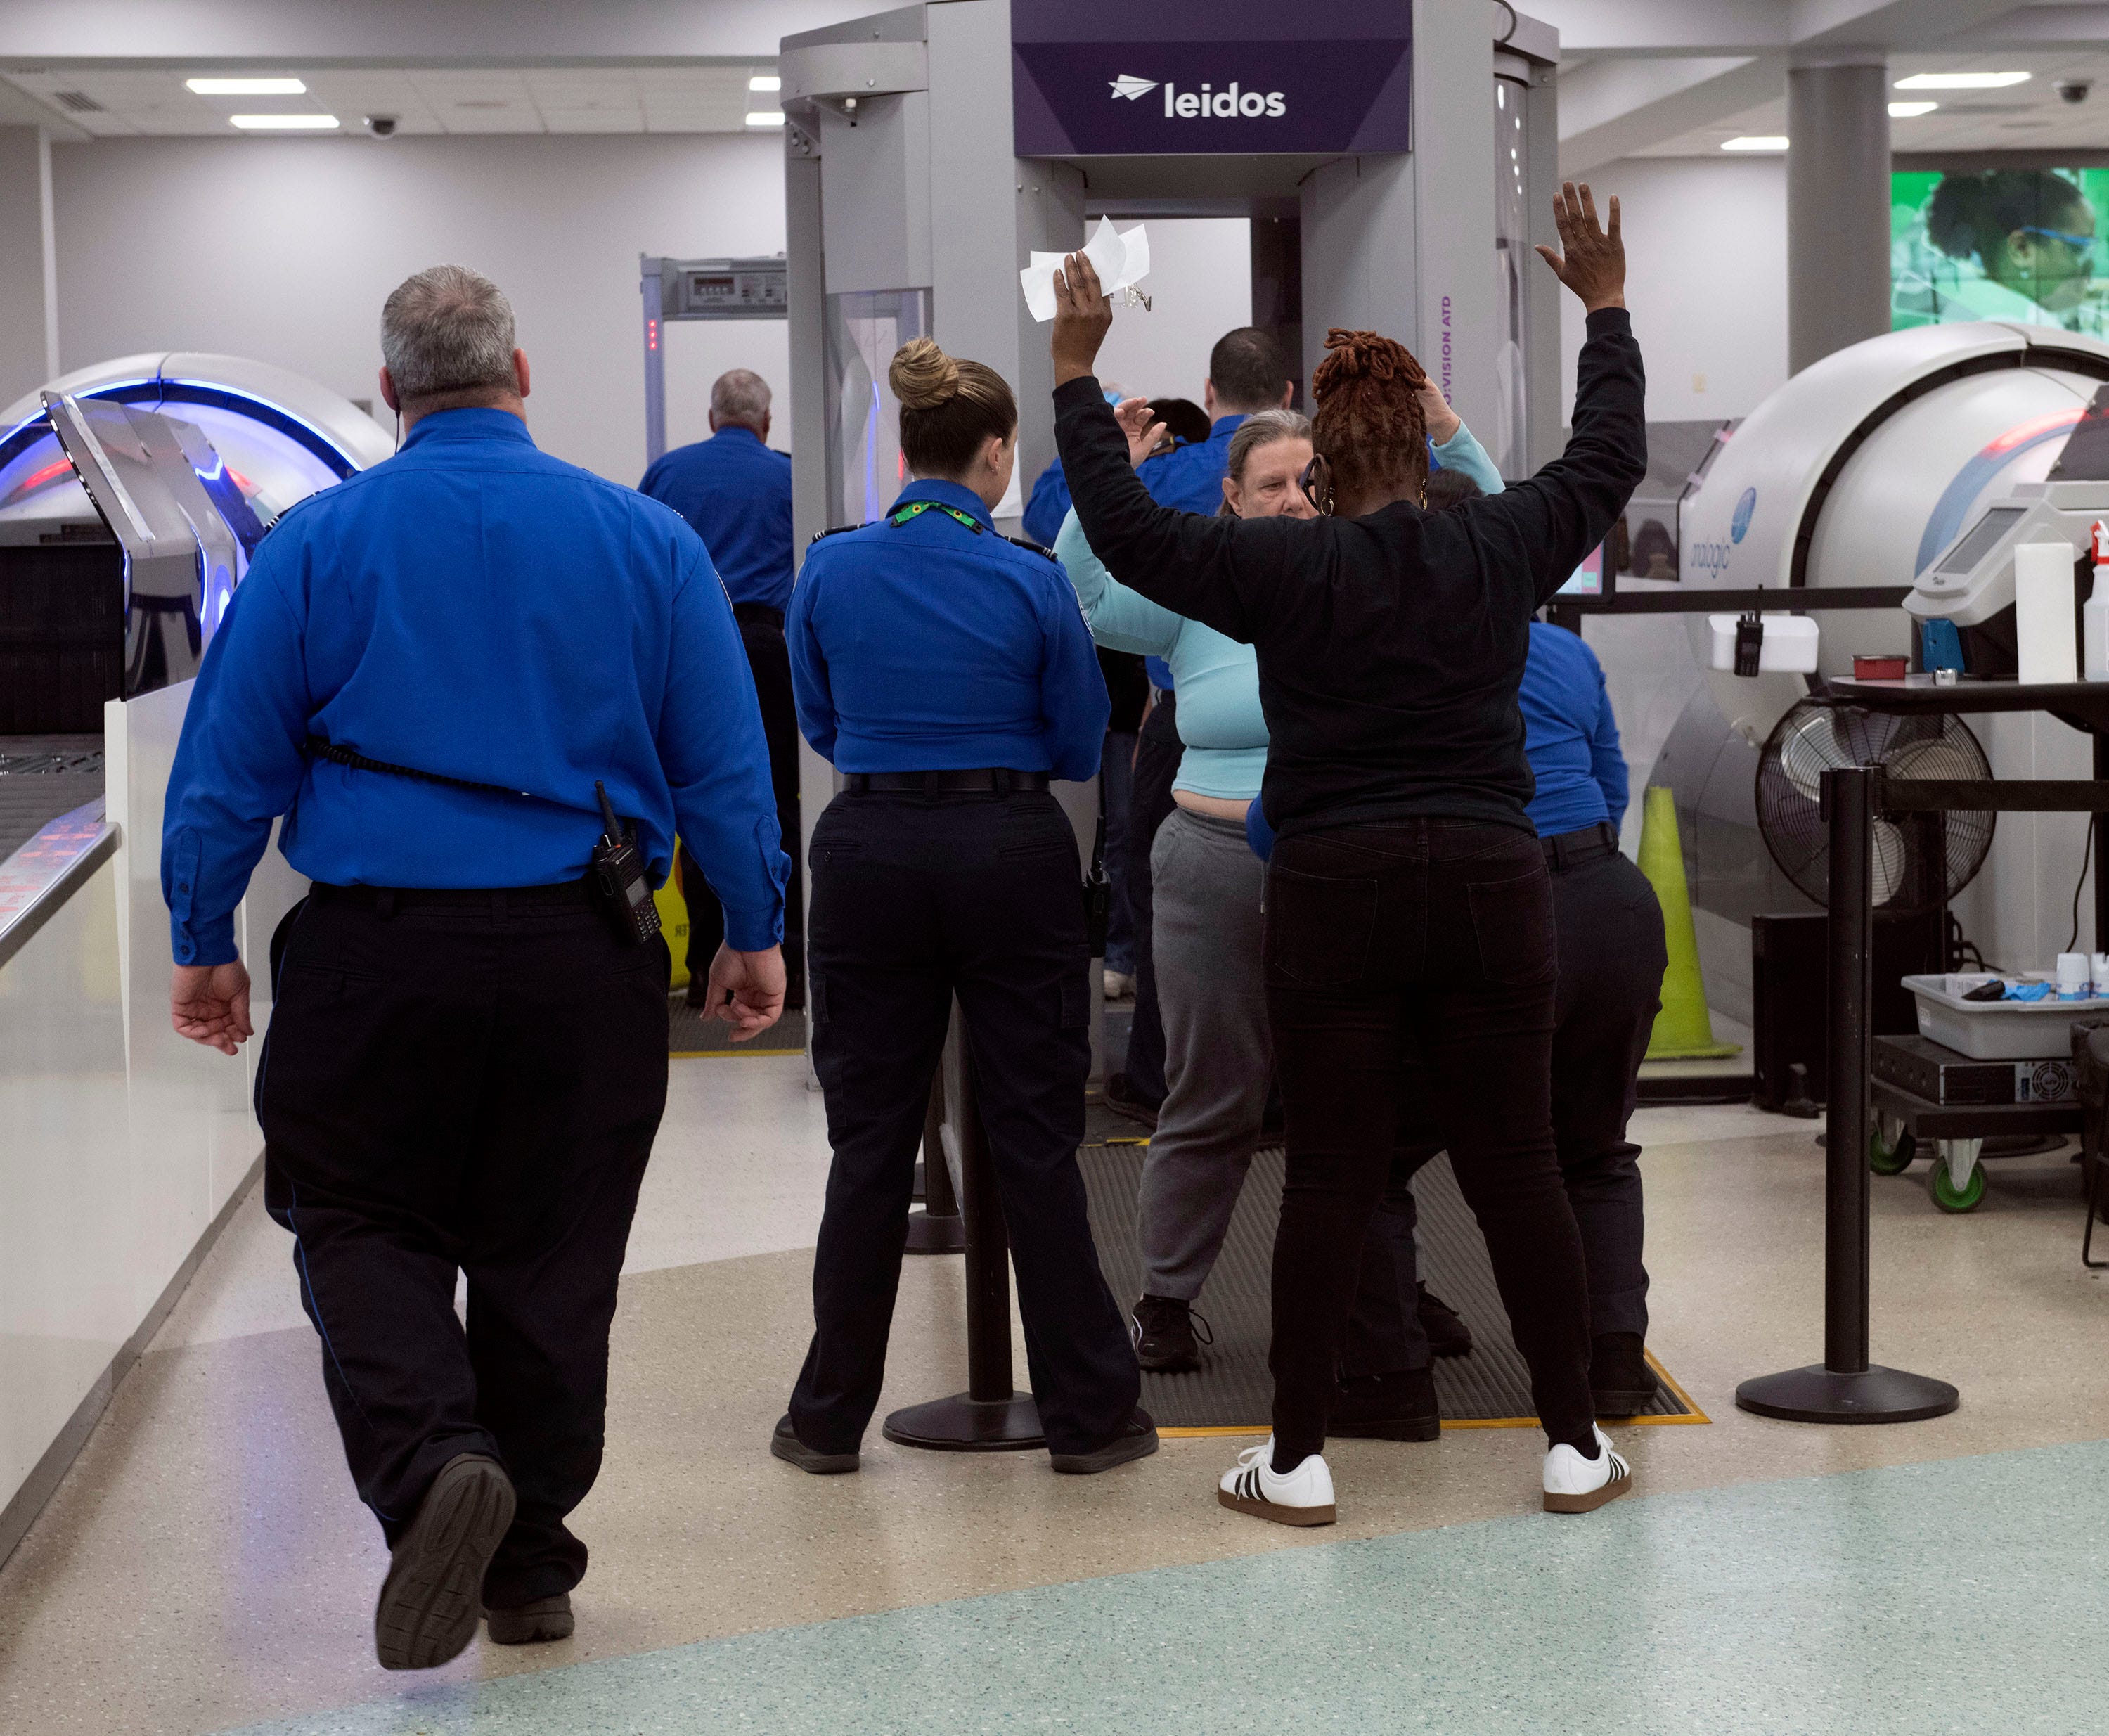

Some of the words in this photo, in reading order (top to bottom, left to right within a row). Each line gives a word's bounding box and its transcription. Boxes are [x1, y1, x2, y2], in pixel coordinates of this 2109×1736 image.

[1165, 82, 1286, 118] leidos
[1442, 295, 1451, 327] ATD
[1442, 332, 1452, 406] O:VISION
